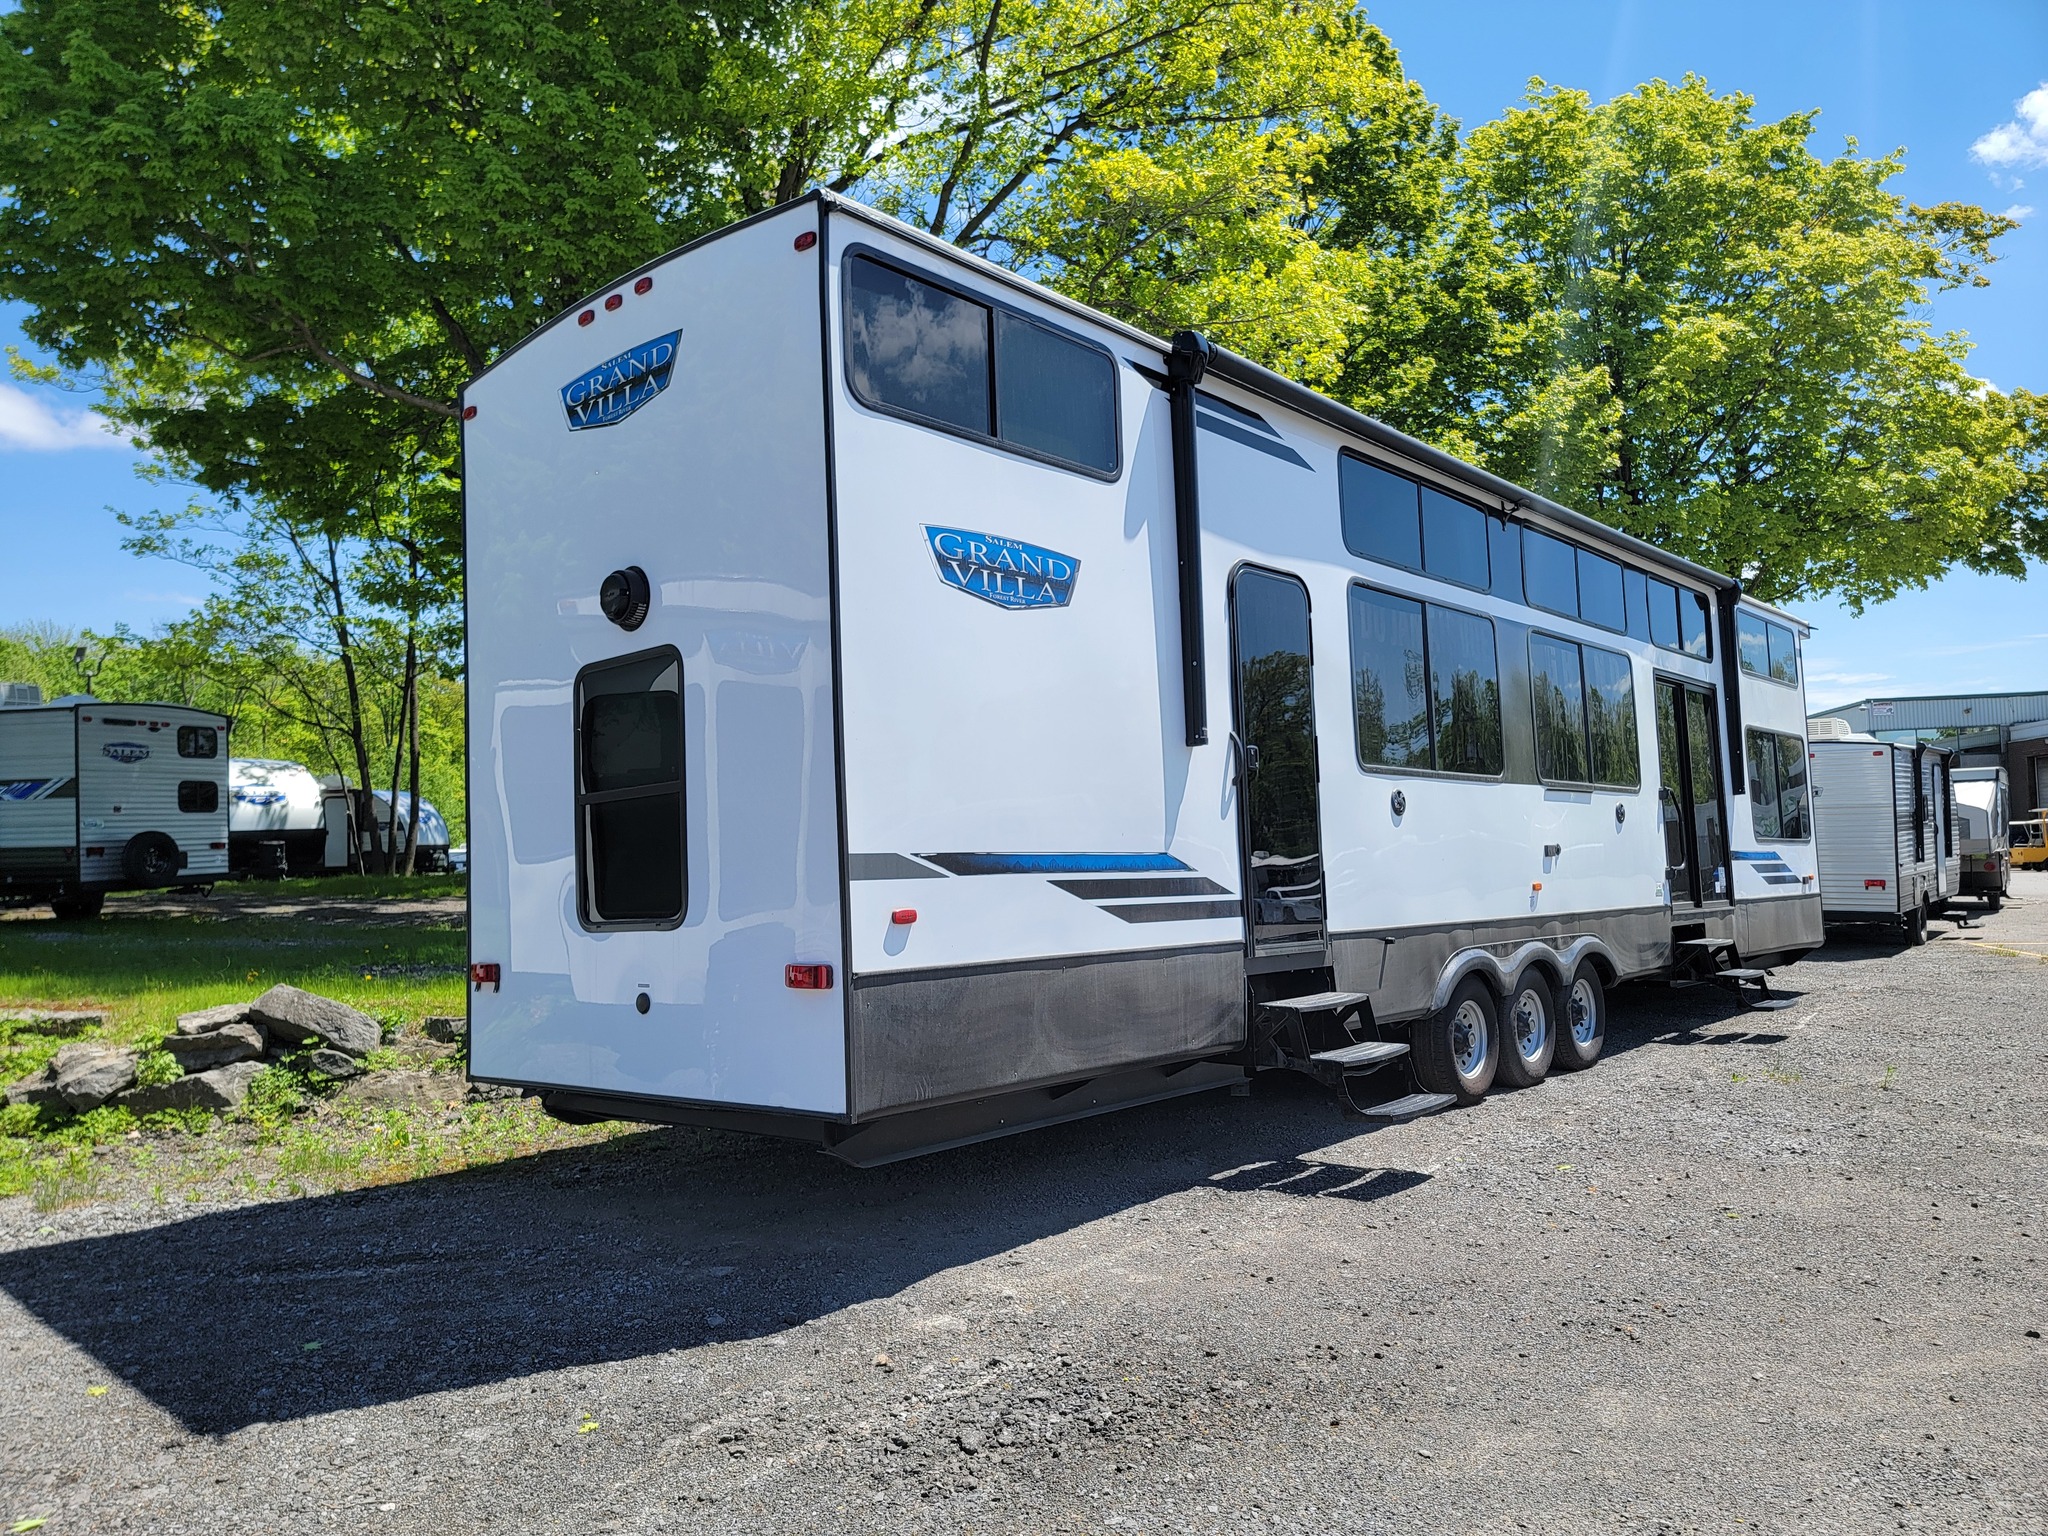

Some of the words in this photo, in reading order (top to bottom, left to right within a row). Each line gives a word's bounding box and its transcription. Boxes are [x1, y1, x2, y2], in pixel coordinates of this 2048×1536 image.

[566, 343, 673, 407] GRAND
[600, 352, 631, 371] SALEM
[574, 374, 661, 425] VILLA
[934, 533, 1071, 581] GRAND
[985, 535, 1023, 550] SALEM
[947, 560, 1059, 604] VILLA
[102, 746, 150, 758] SALEM
